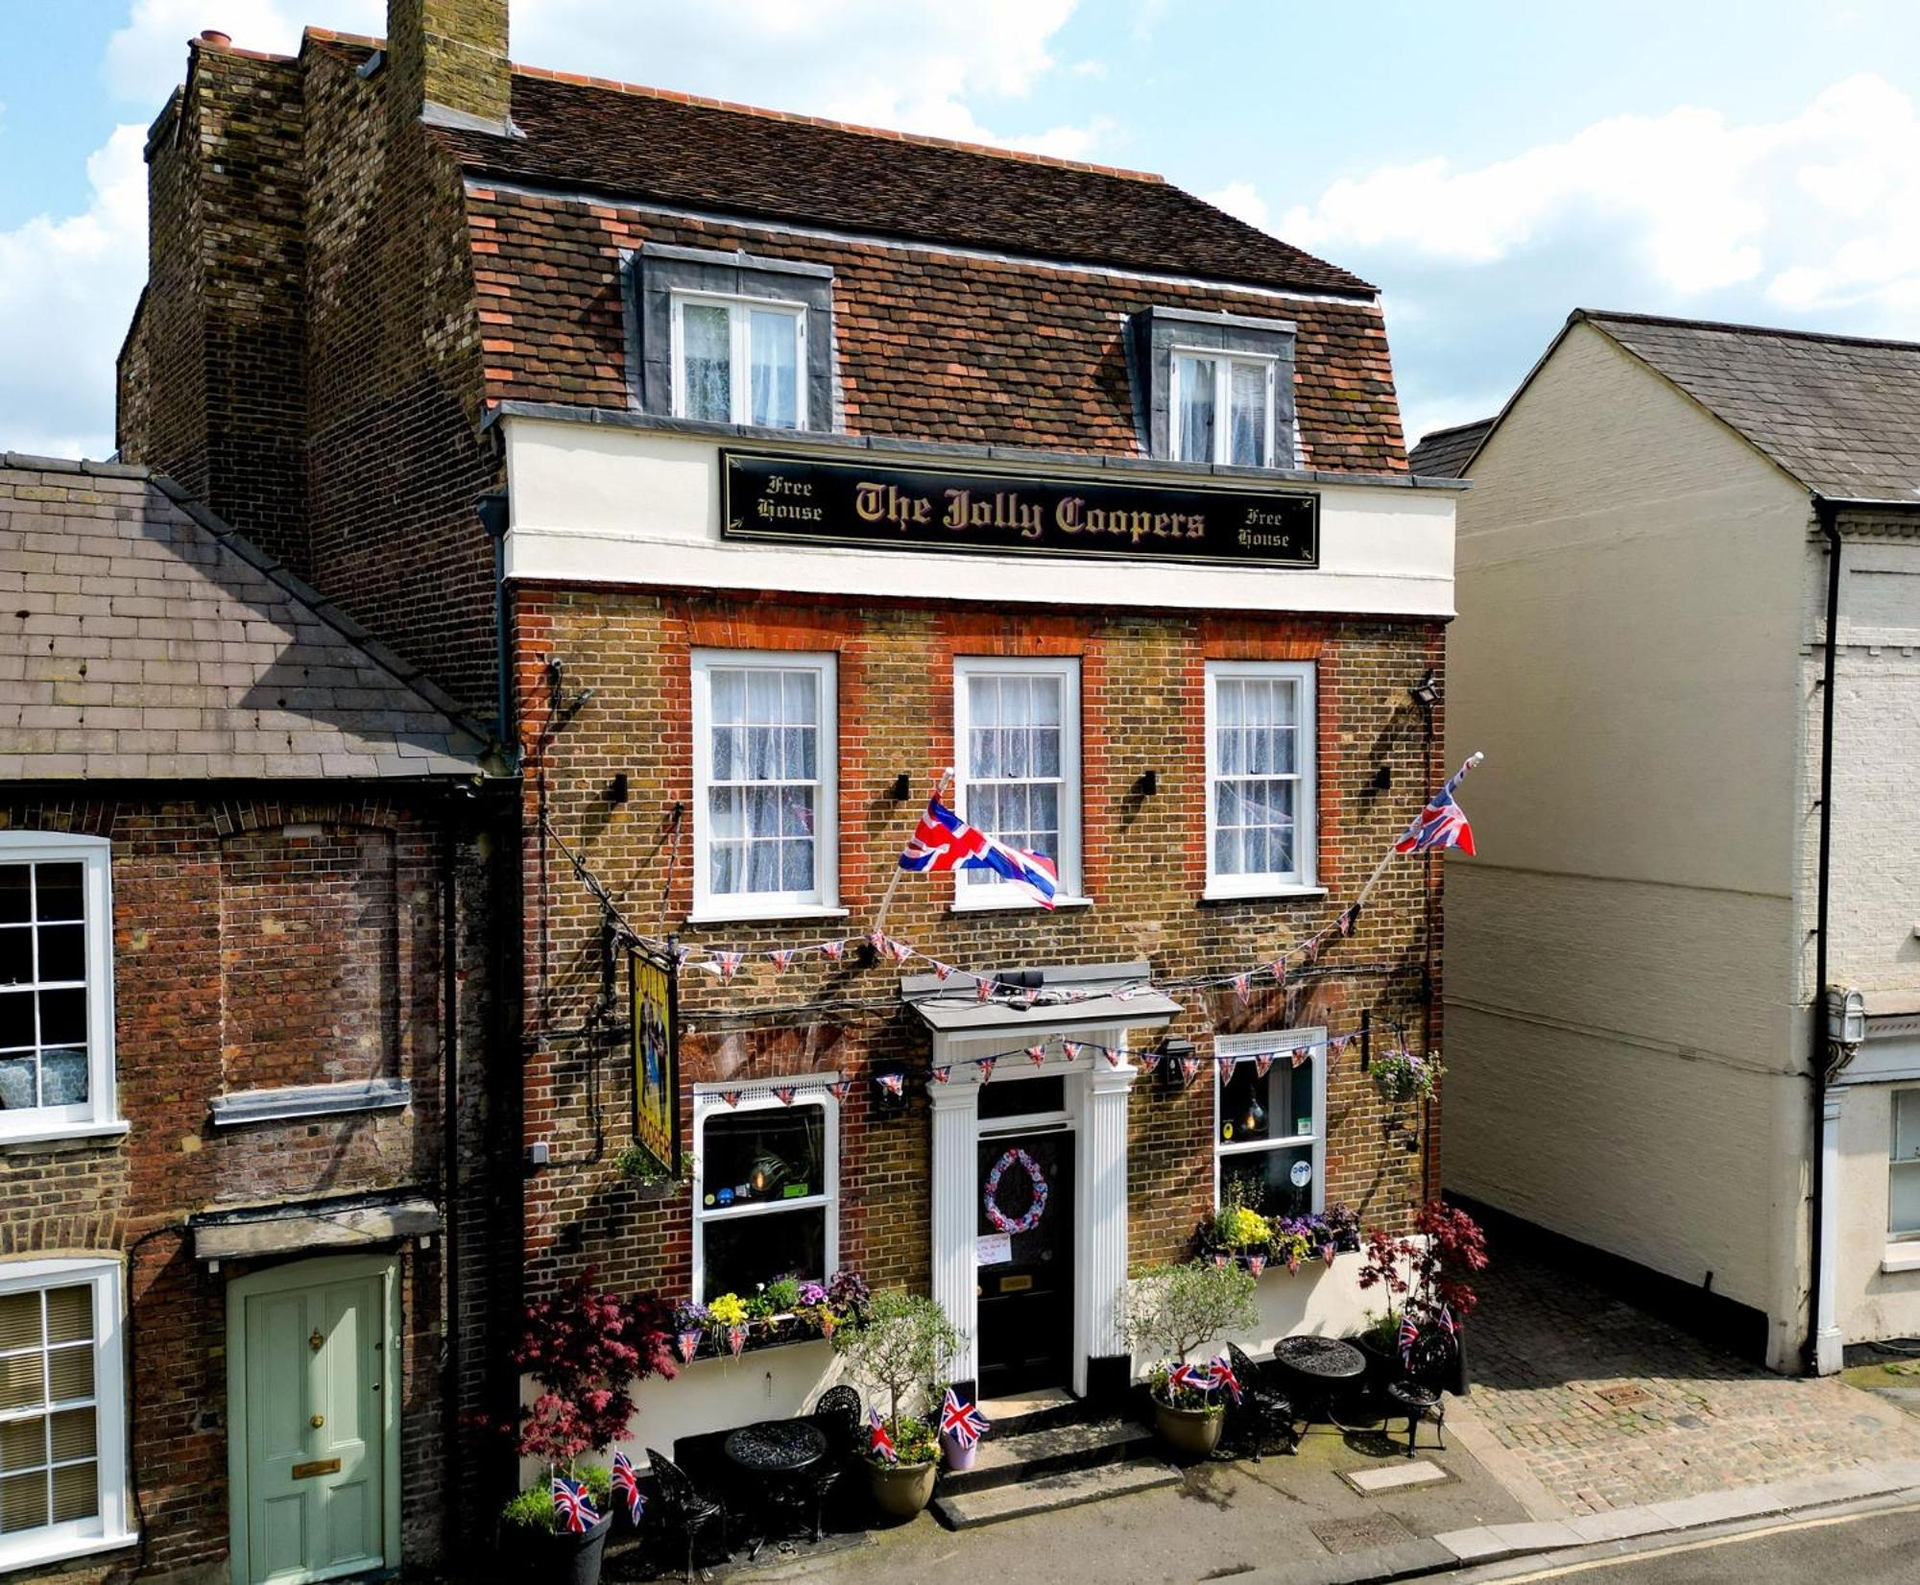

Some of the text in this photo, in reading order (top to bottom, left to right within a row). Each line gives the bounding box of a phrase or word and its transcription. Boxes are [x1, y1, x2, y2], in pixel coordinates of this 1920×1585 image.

[765, 475, 813, 497] Free
[757, 498, 823, 522] House
[856, 481, 1206, 544] The Jolly Coopers
[1245, 508, 1283, 526] Free
[1238, 528, 1290, 549] House
